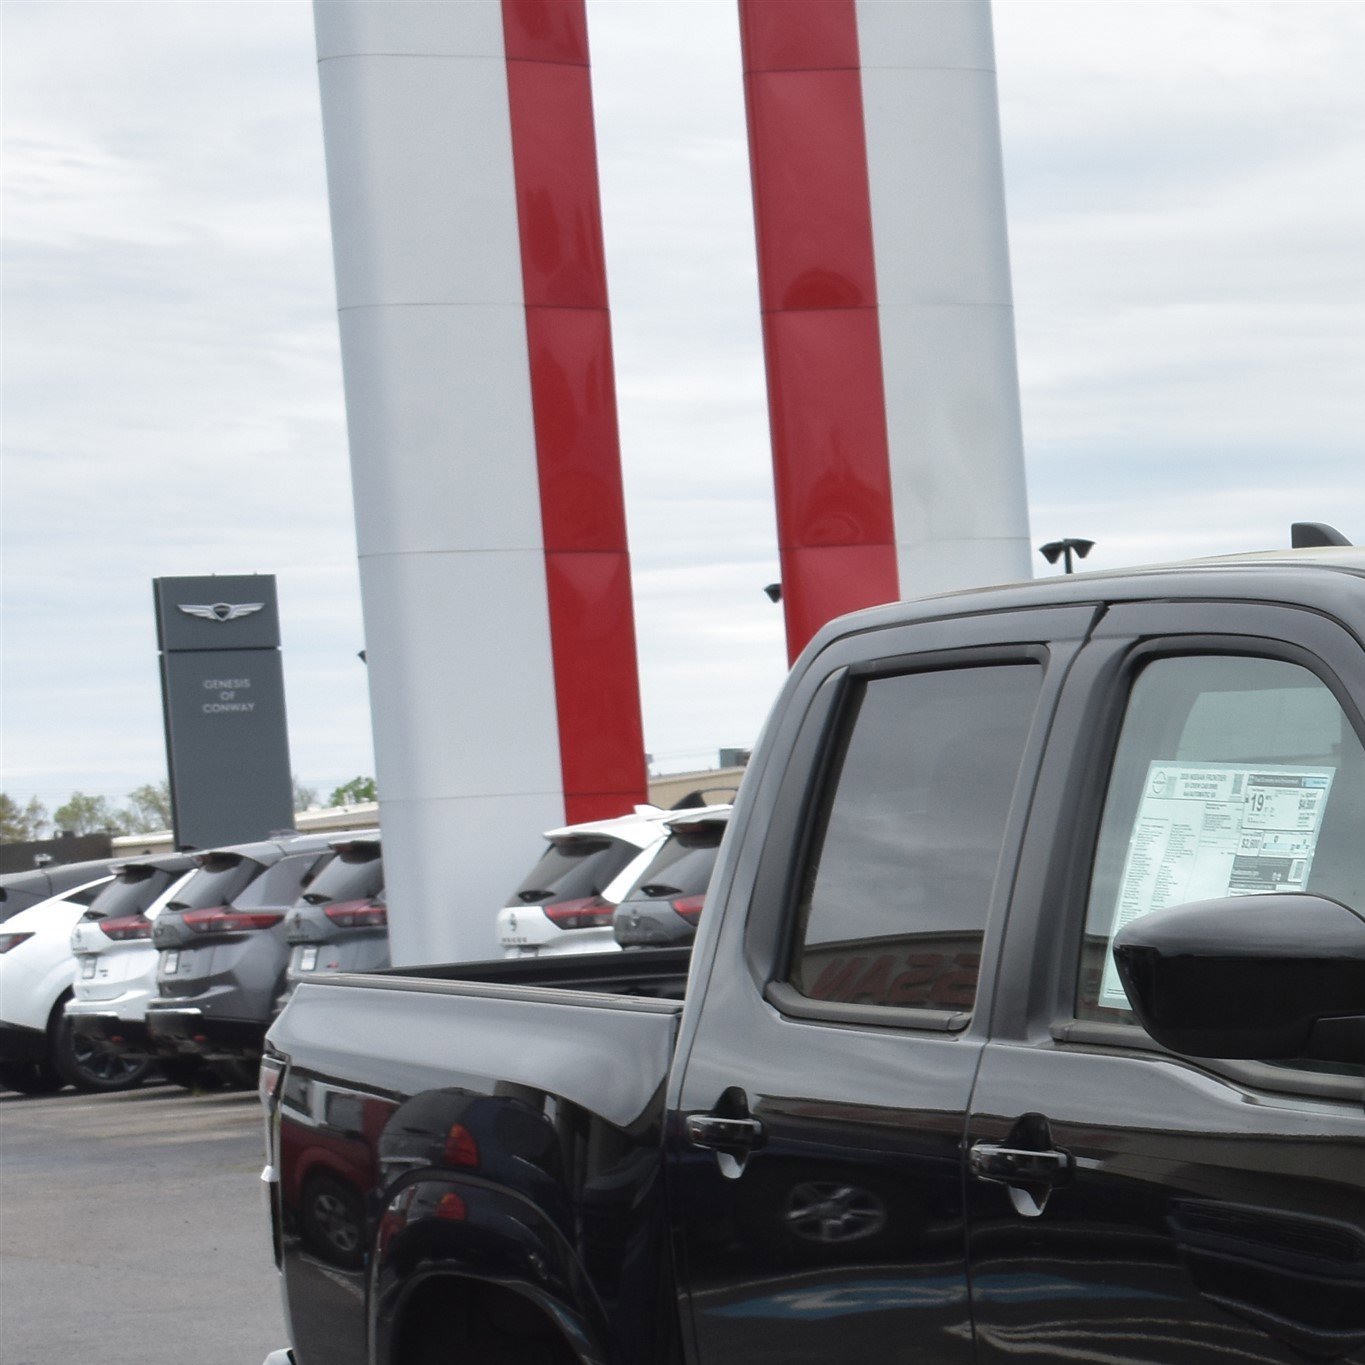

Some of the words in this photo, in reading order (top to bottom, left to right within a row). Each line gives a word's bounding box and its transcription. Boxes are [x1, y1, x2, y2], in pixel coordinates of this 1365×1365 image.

[203, 679, 251, 690] GENESIS
[220, 691, 236, 701] OF
[202, 702, 255, 714] CONWAY
[1250, 794, 1265, 812] 19
